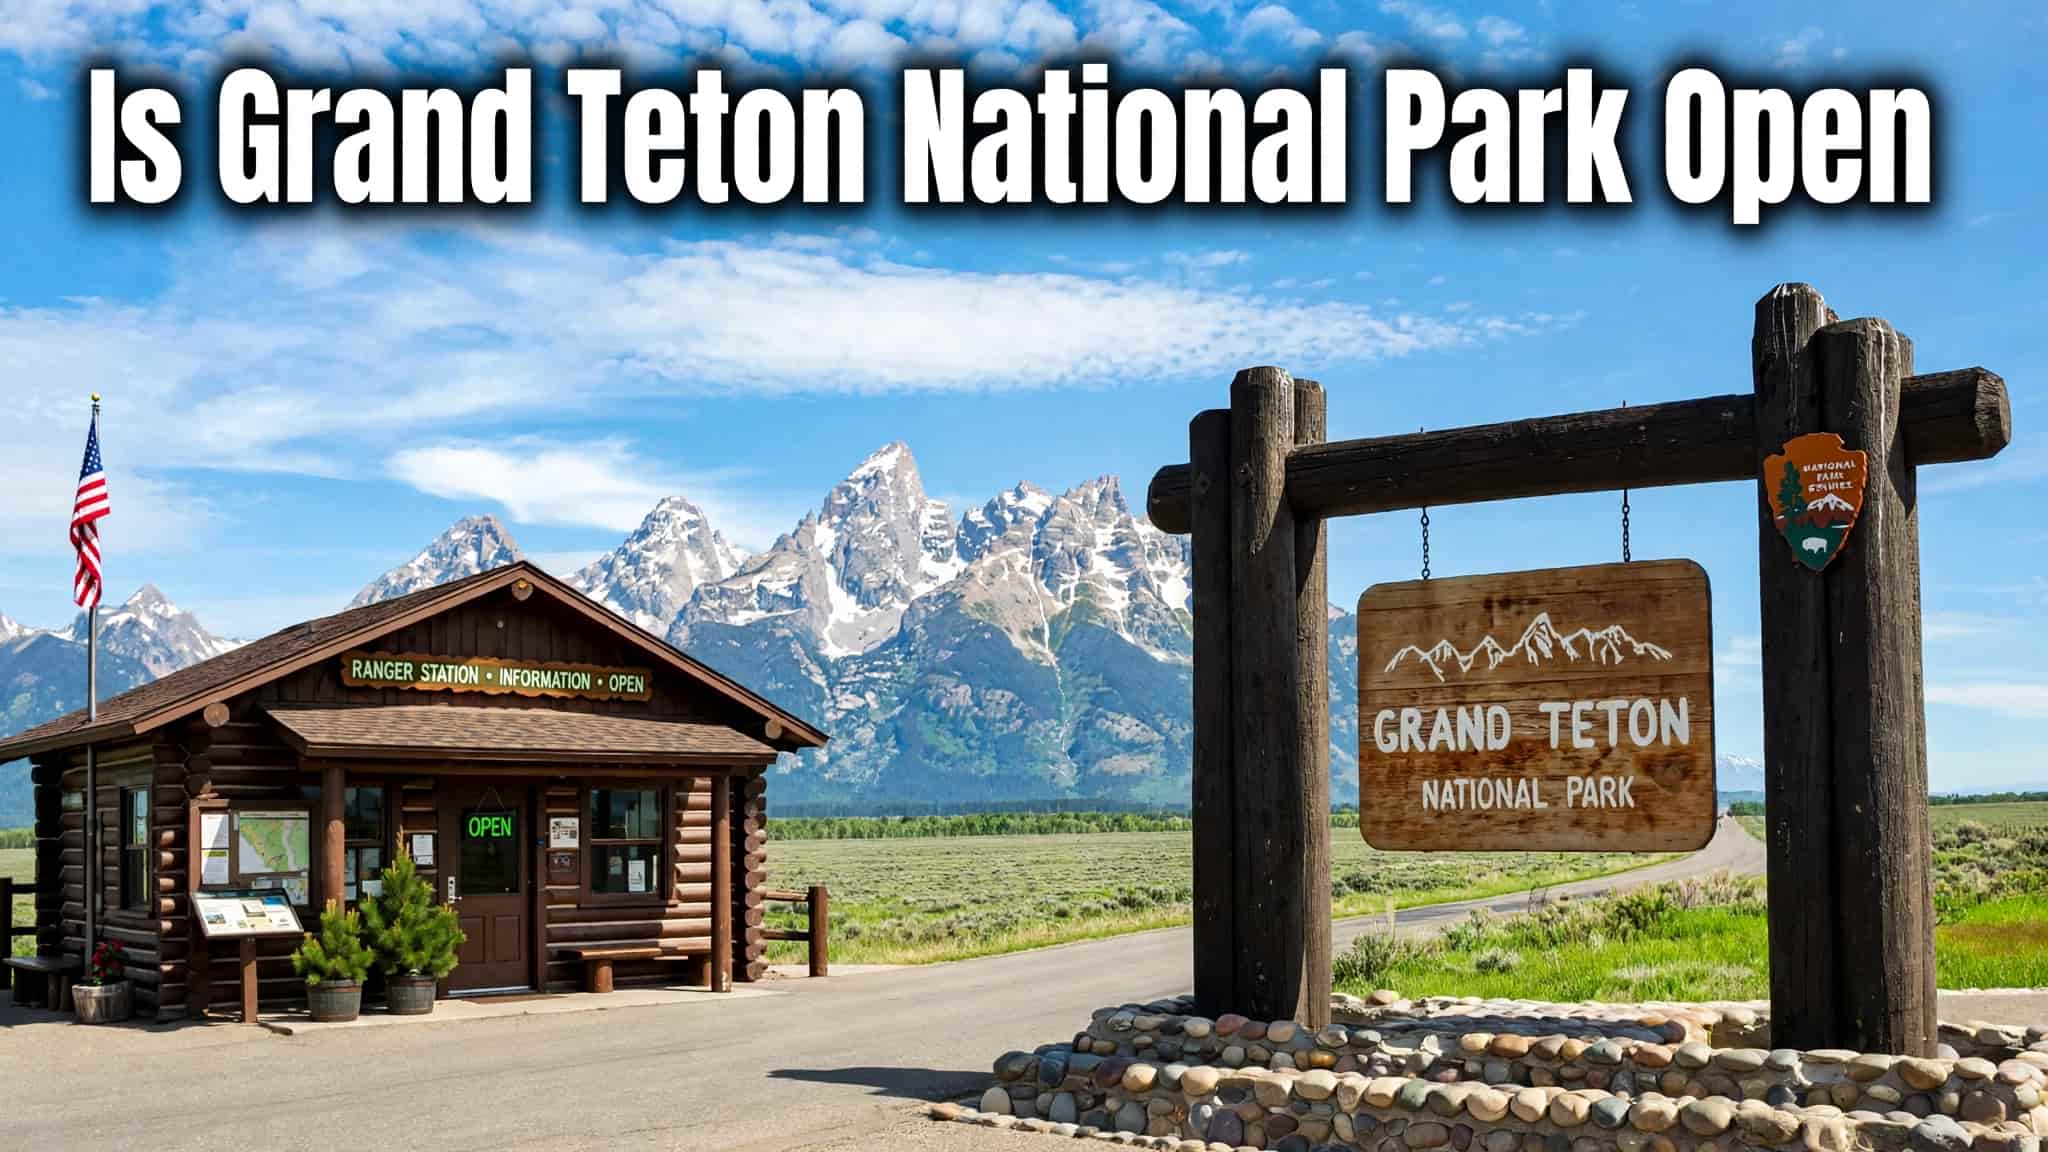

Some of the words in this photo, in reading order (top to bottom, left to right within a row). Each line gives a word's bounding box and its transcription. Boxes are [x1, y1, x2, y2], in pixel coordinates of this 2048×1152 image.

[352, 659, 414, 681] RANGER
[420, 663, 479, 685] STATION
[499, 667, 591, 690] INFORMATION
[609, 674, 645, 693] OPEN
[1373, 703, 1511, 753] GRAND
[1539, 697, 1690, 749] TETON
[1422, 776, 1548, 810] NATIONAL
[1567, 775, 1635, 809] PARK
[468, 816, 512, 838] OPEN
